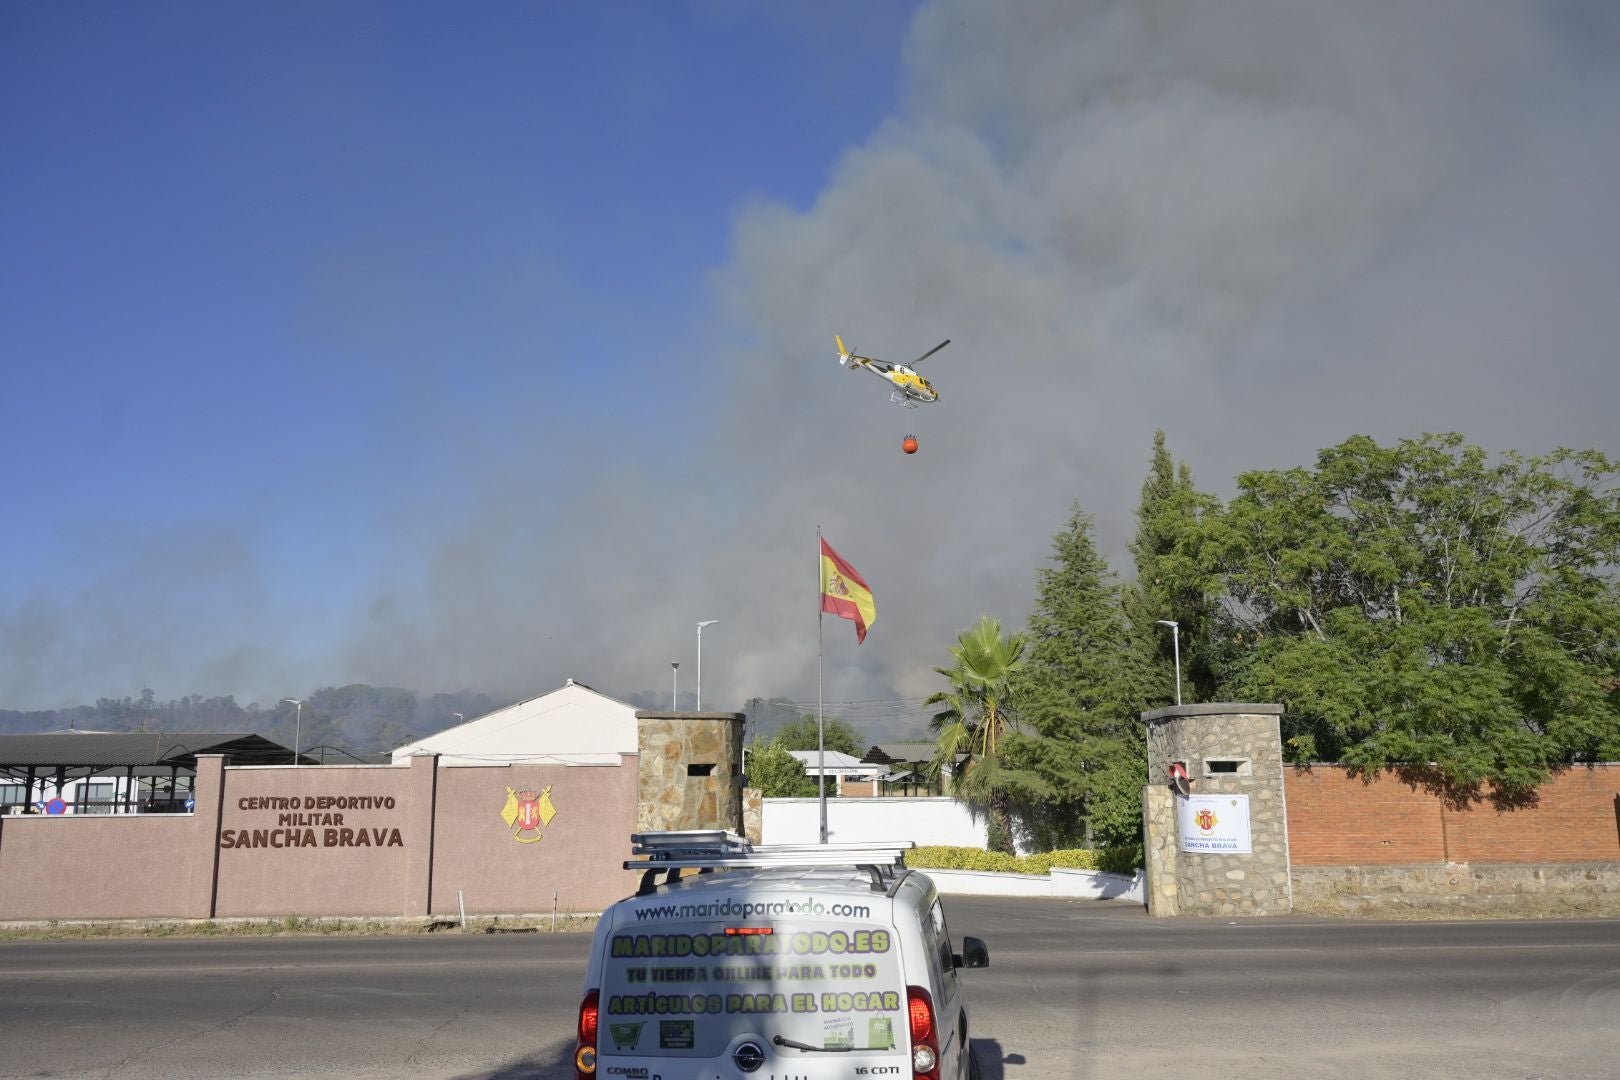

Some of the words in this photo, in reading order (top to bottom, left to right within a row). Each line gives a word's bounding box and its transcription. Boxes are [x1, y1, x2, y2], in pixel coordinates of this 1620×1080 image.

[900, 367, 905, 375] 6
[238, 796, 301, 811] CENTRO
[304, 796, 396, 810] DEPORTIVO
[278, 812, 345, 826] MILITAR
[220, 828, 318, 849] SANCHA
[323, 827, 404, 848] BRAVA
[611, 931, 891, 957] MARIDOPARATODO.ES
[626, 967, 647, 983] TU
[651, 966, 708, 983] TIENDA
[712, 964, 773, 982] ONLINE
[777, 964, 825, 980] PARA
[830, 963, 877, 980] TODO
[608, 991, 723, 1014] ARTÍCULOS
[725, 992, 788, 1014] PARA
[791, 992, 818, 1013] EL
[821, 991, 900, 1012] HOGAR
[606, 1066, 649, 1075] COMBO
